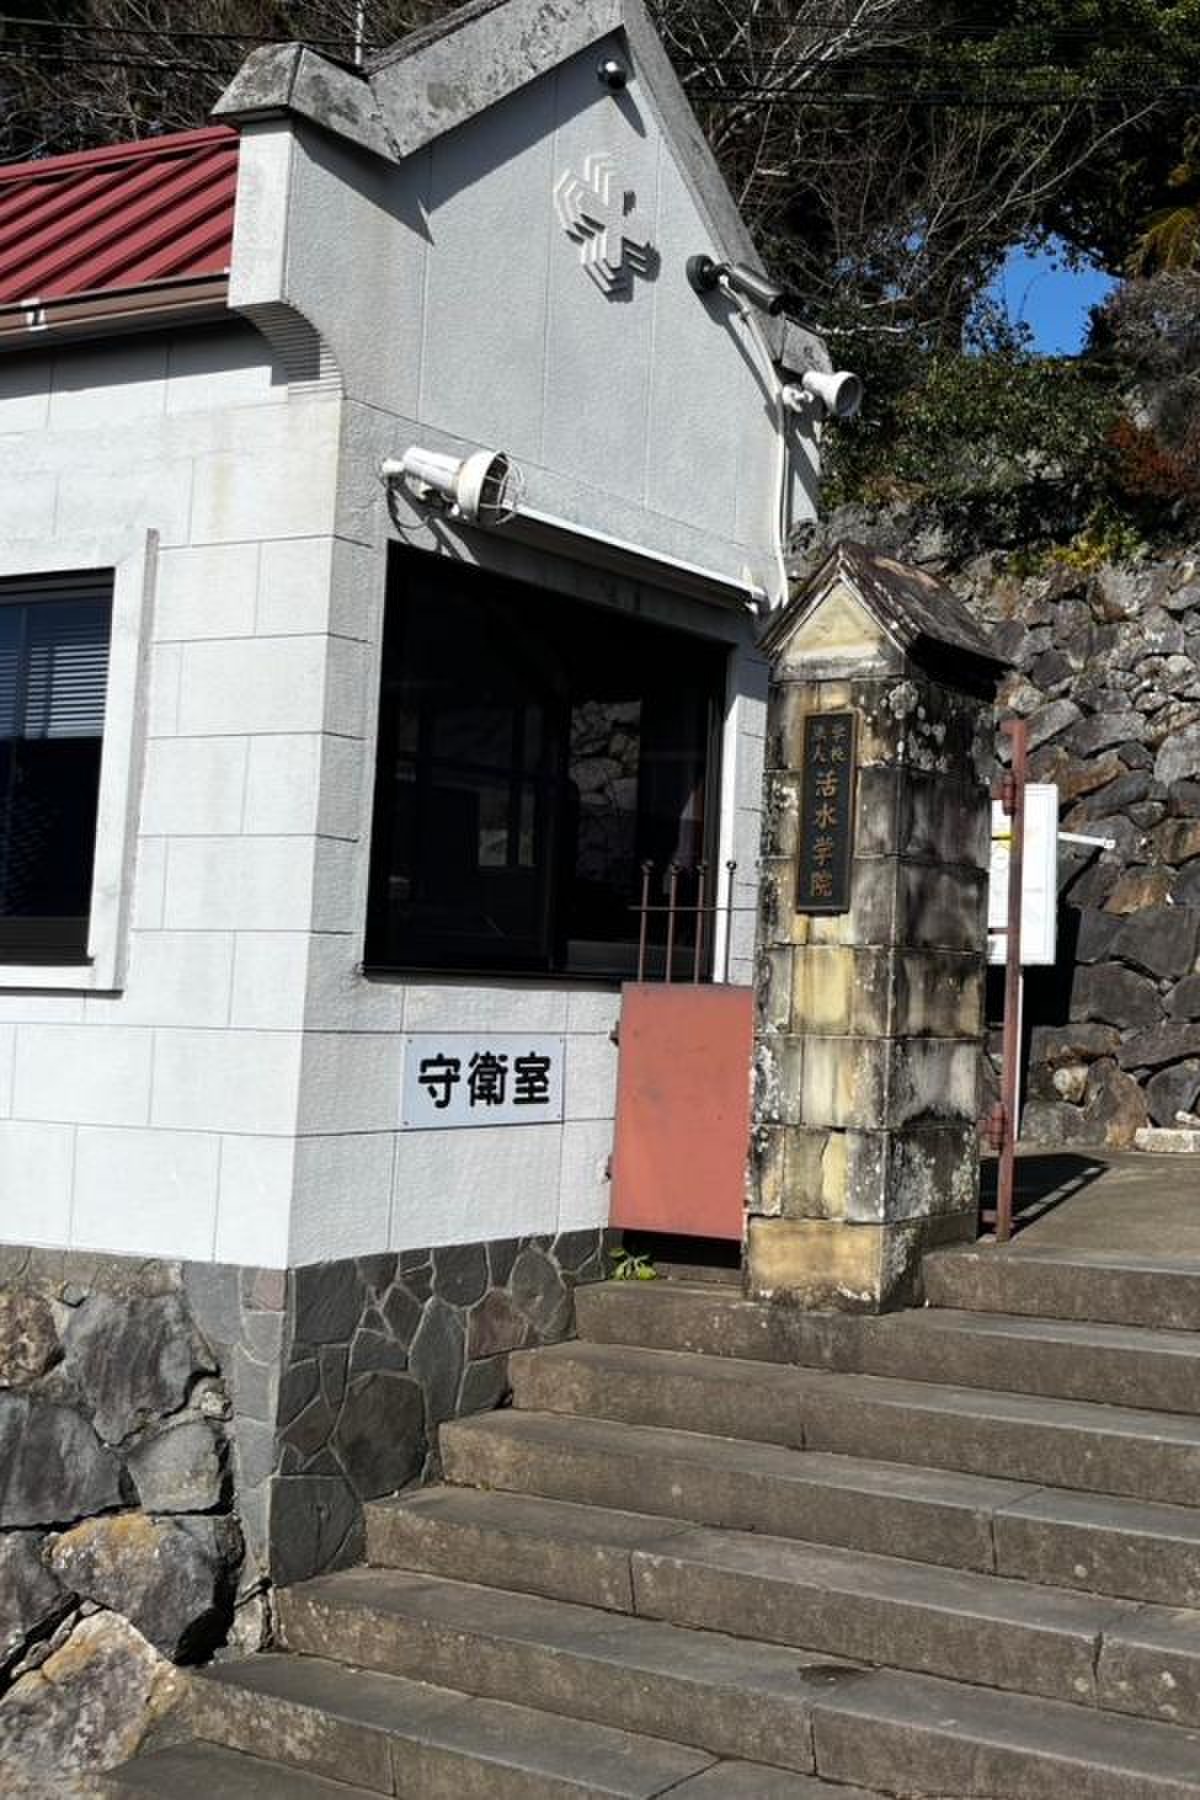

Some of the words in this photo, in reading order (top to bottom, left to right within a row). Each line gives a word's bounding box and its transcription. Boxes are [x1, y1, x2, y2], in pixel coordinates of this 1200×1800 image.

[811, 771, 838, 897] 活水学院
[418, 1051, 551, 1108] 守衛室
